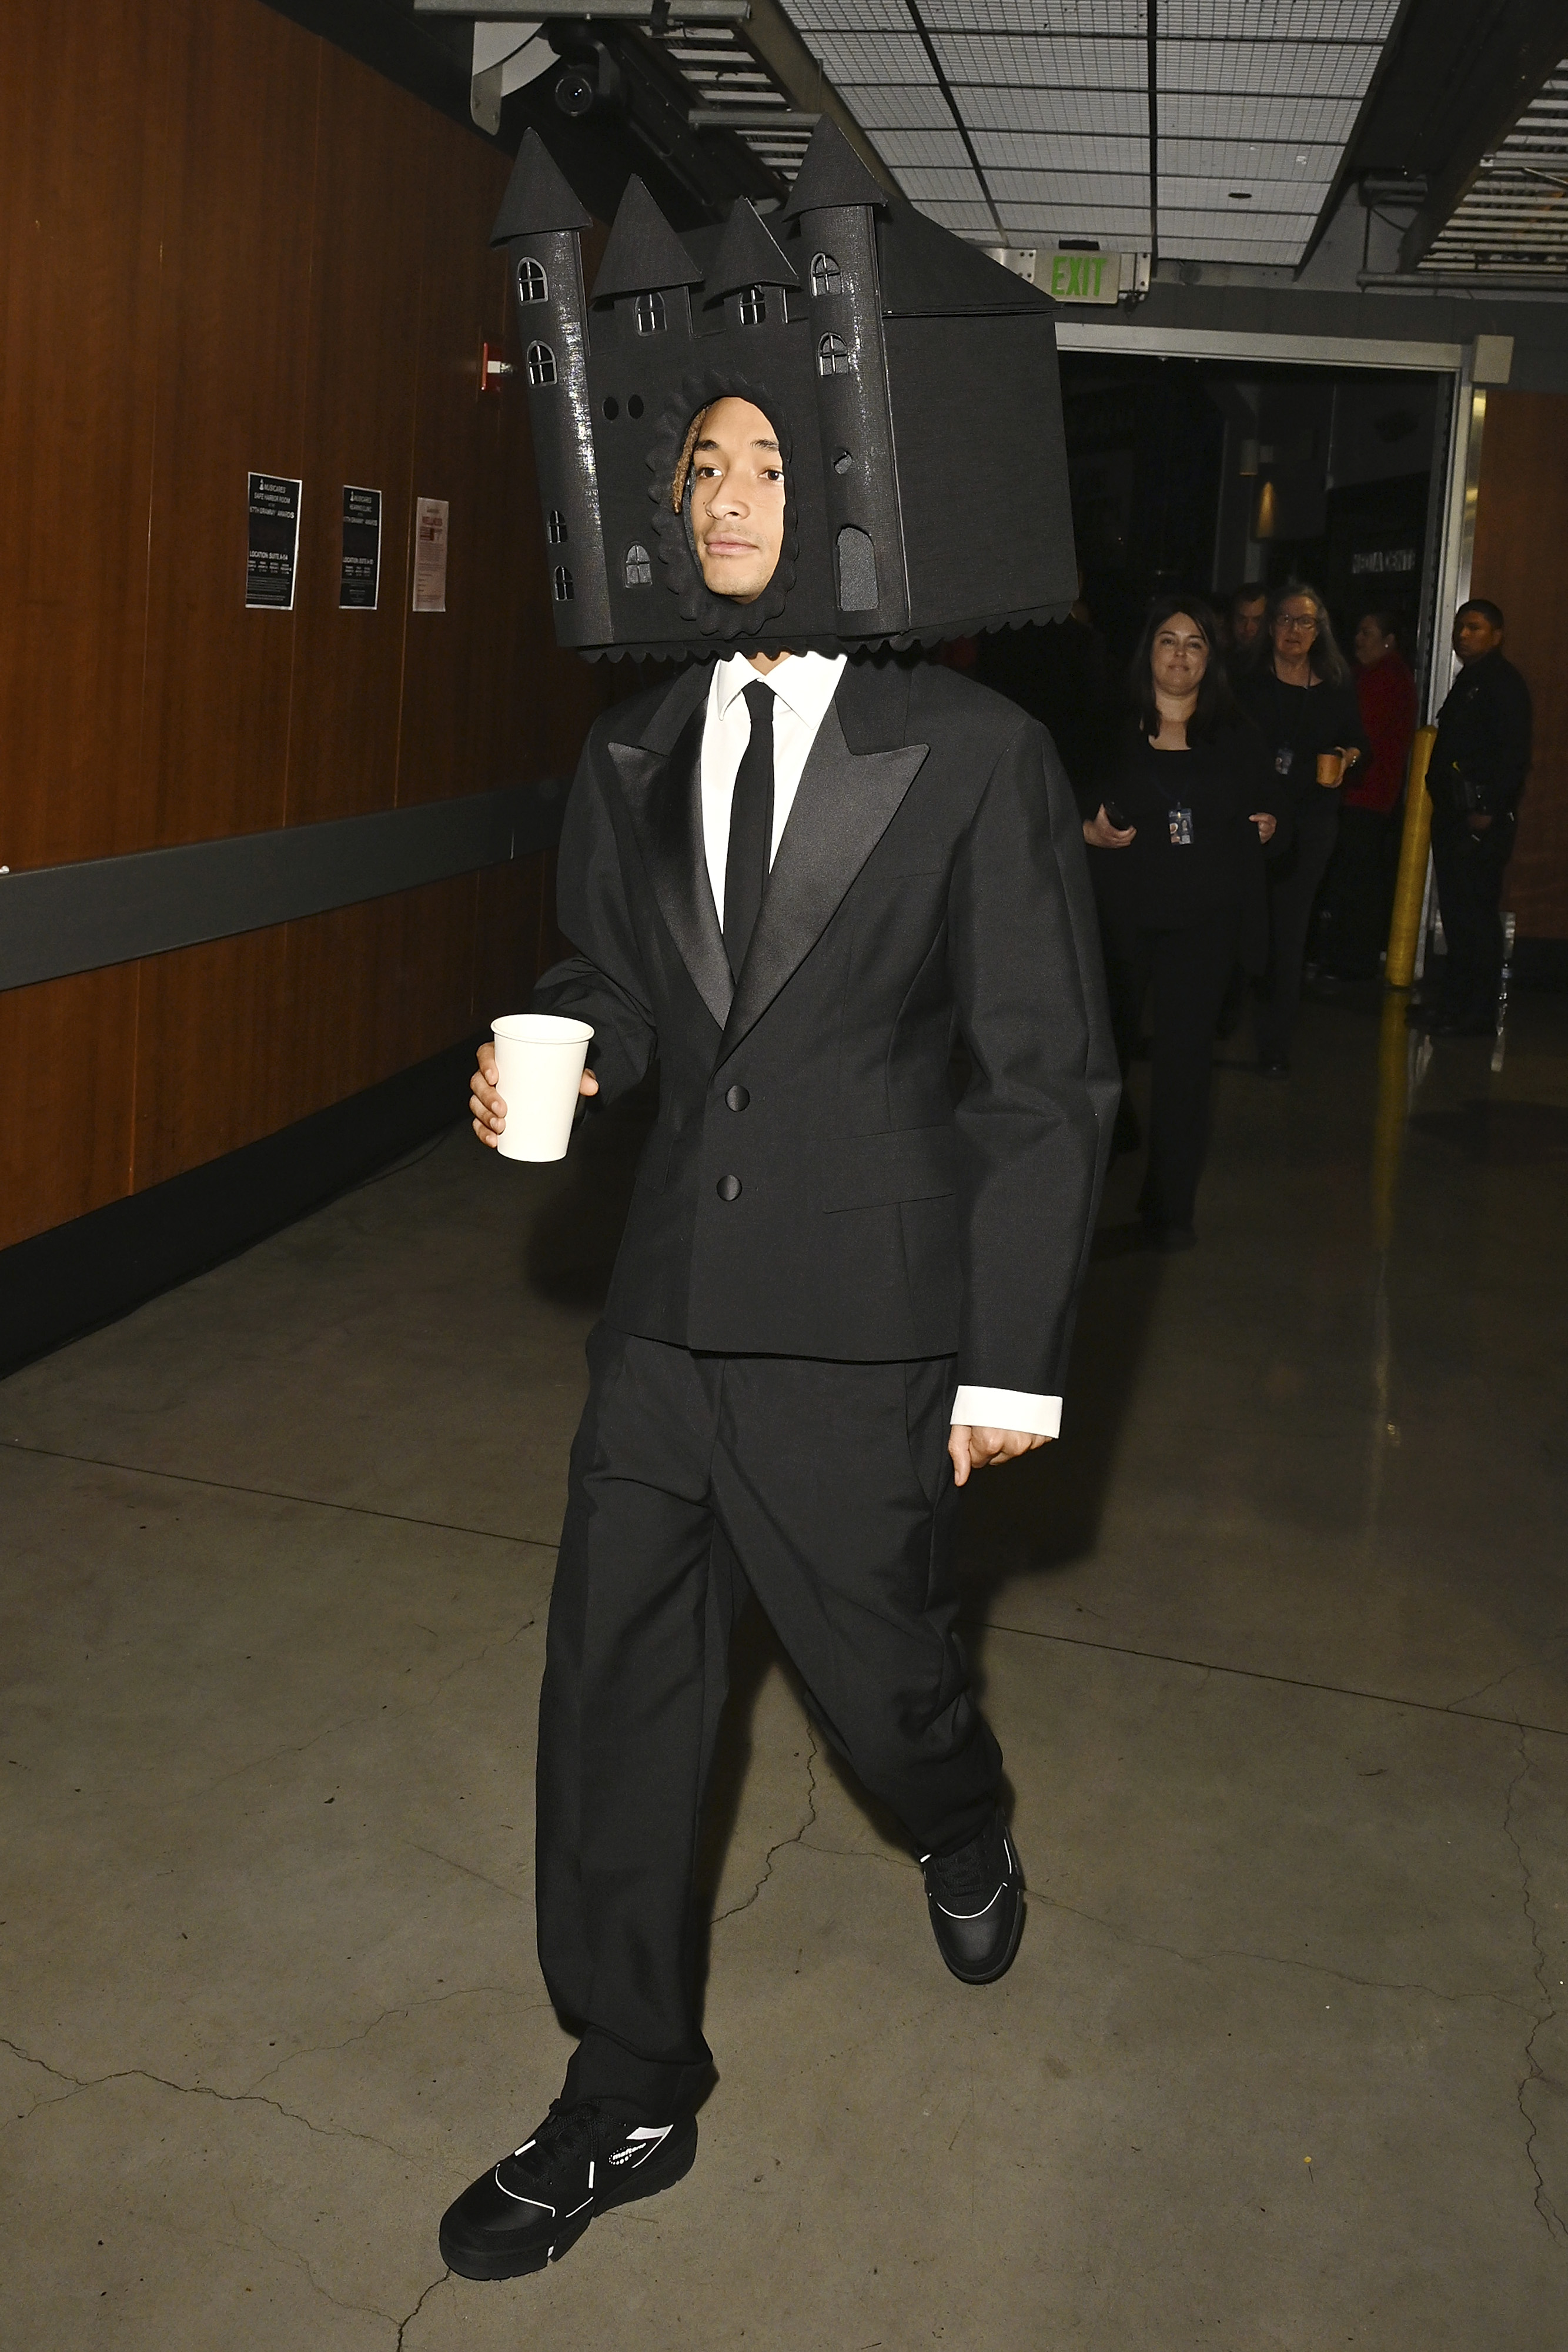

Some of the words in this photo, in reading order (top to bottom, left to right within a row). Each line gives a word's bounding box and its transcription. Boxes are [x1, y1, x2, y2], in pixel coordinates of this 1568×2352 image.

[1051, 256, 1107, 296] EXIT
[254, 492, 264, 500] SAFE
[277, 510, 295, 519] AWARDS
